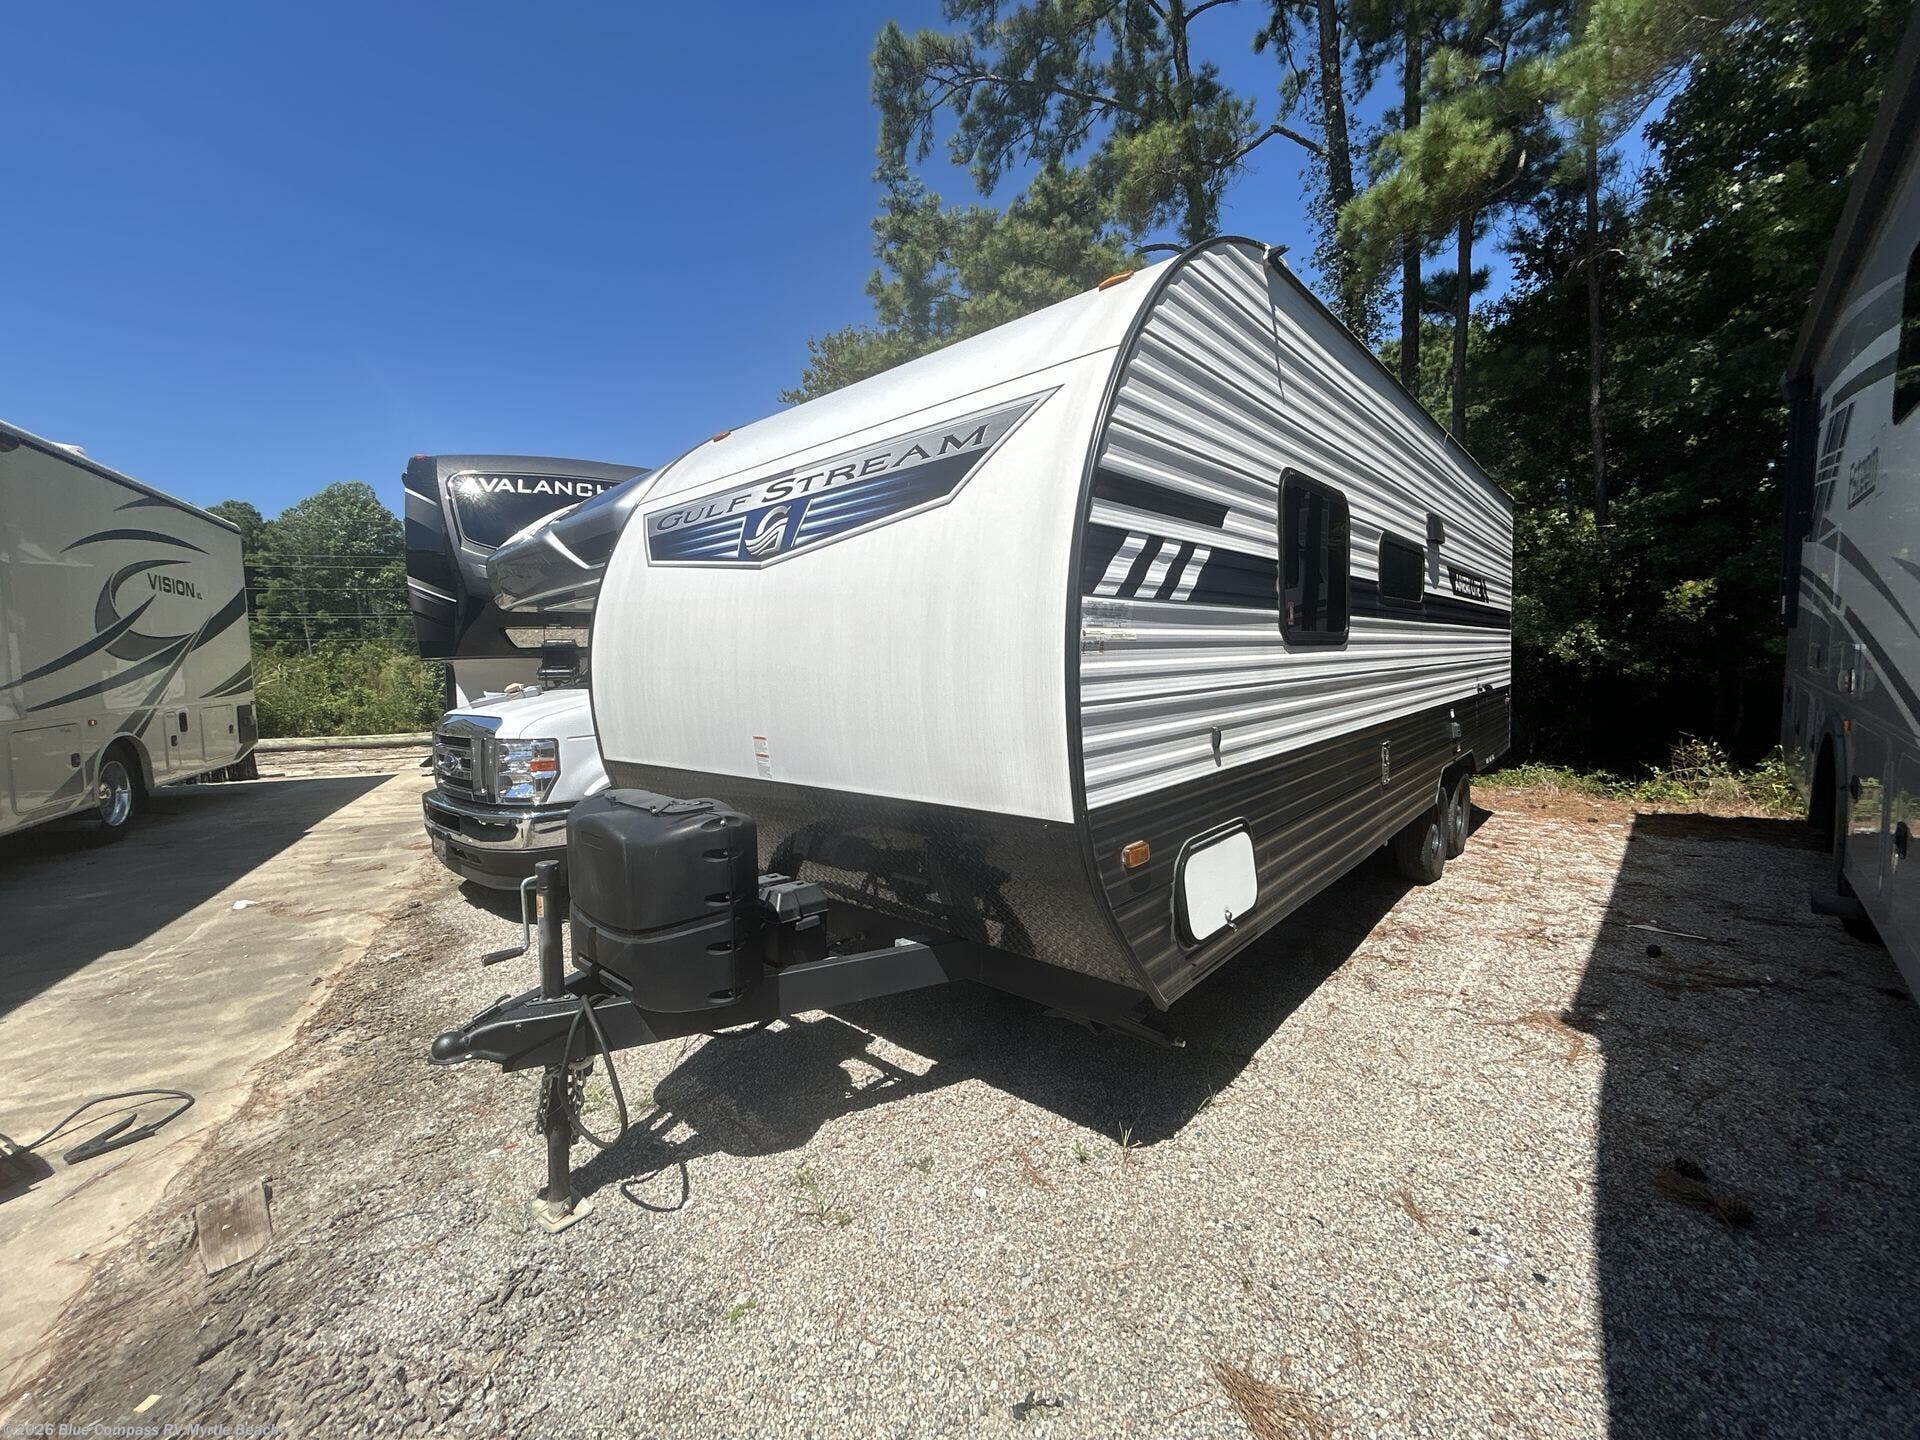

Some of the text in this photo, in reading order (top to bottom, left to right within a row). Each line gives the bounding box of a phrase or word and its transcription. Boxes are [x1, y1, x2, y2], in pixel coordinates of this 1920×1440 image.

[656, 423, 990, 531] GULF STREAM
[146, 572, 195, 599] VISION
